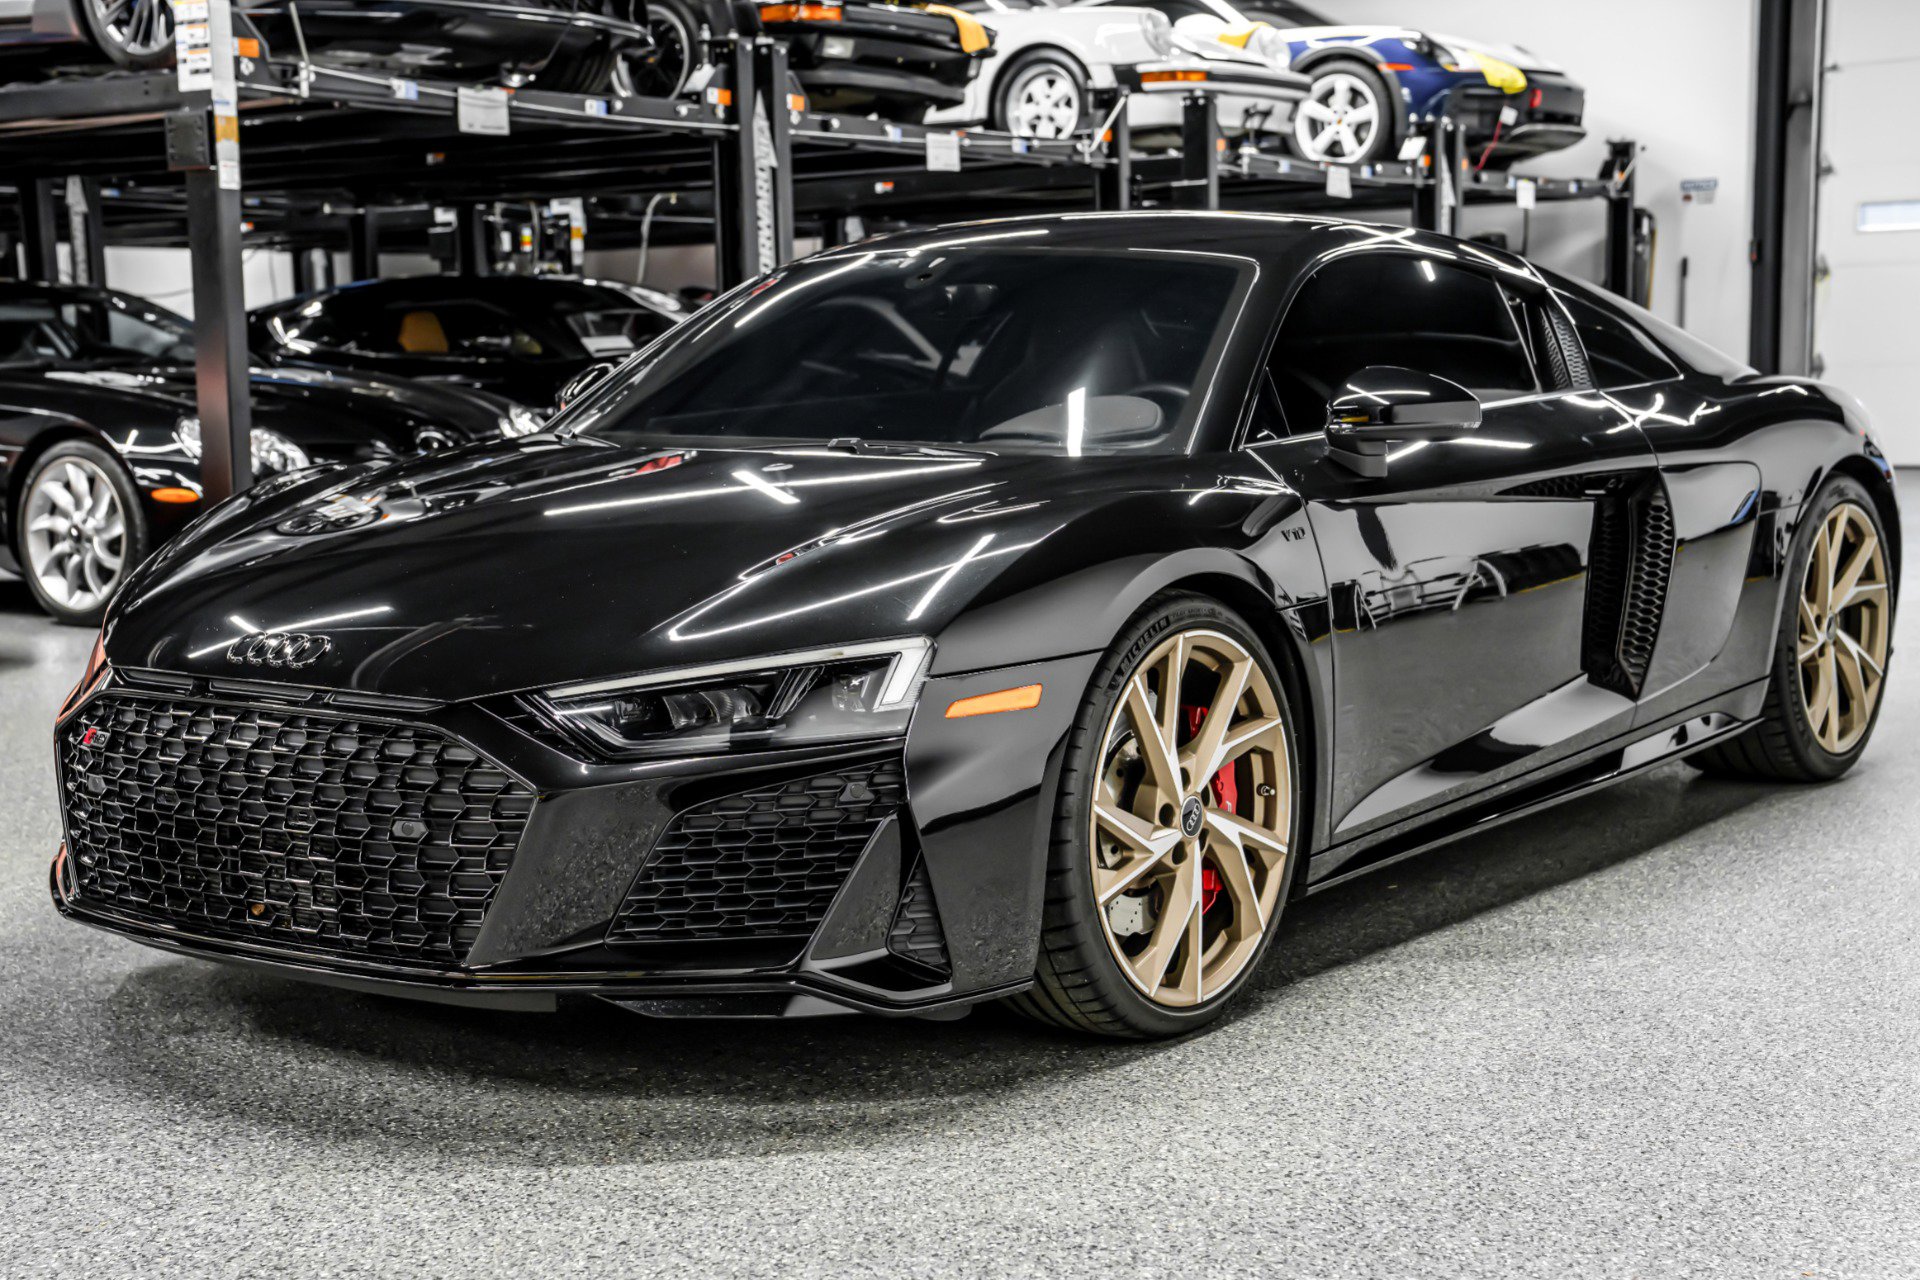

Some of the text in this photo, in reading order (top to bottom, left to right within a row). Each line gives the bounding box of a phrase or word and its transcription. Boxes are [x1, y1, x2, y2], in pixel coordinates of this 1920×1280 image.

[756, 166, 775, 275] ORWARD
[1281, 527, 1305, 541] V10
[1120, 617, 1168, 672] MICHELIN
